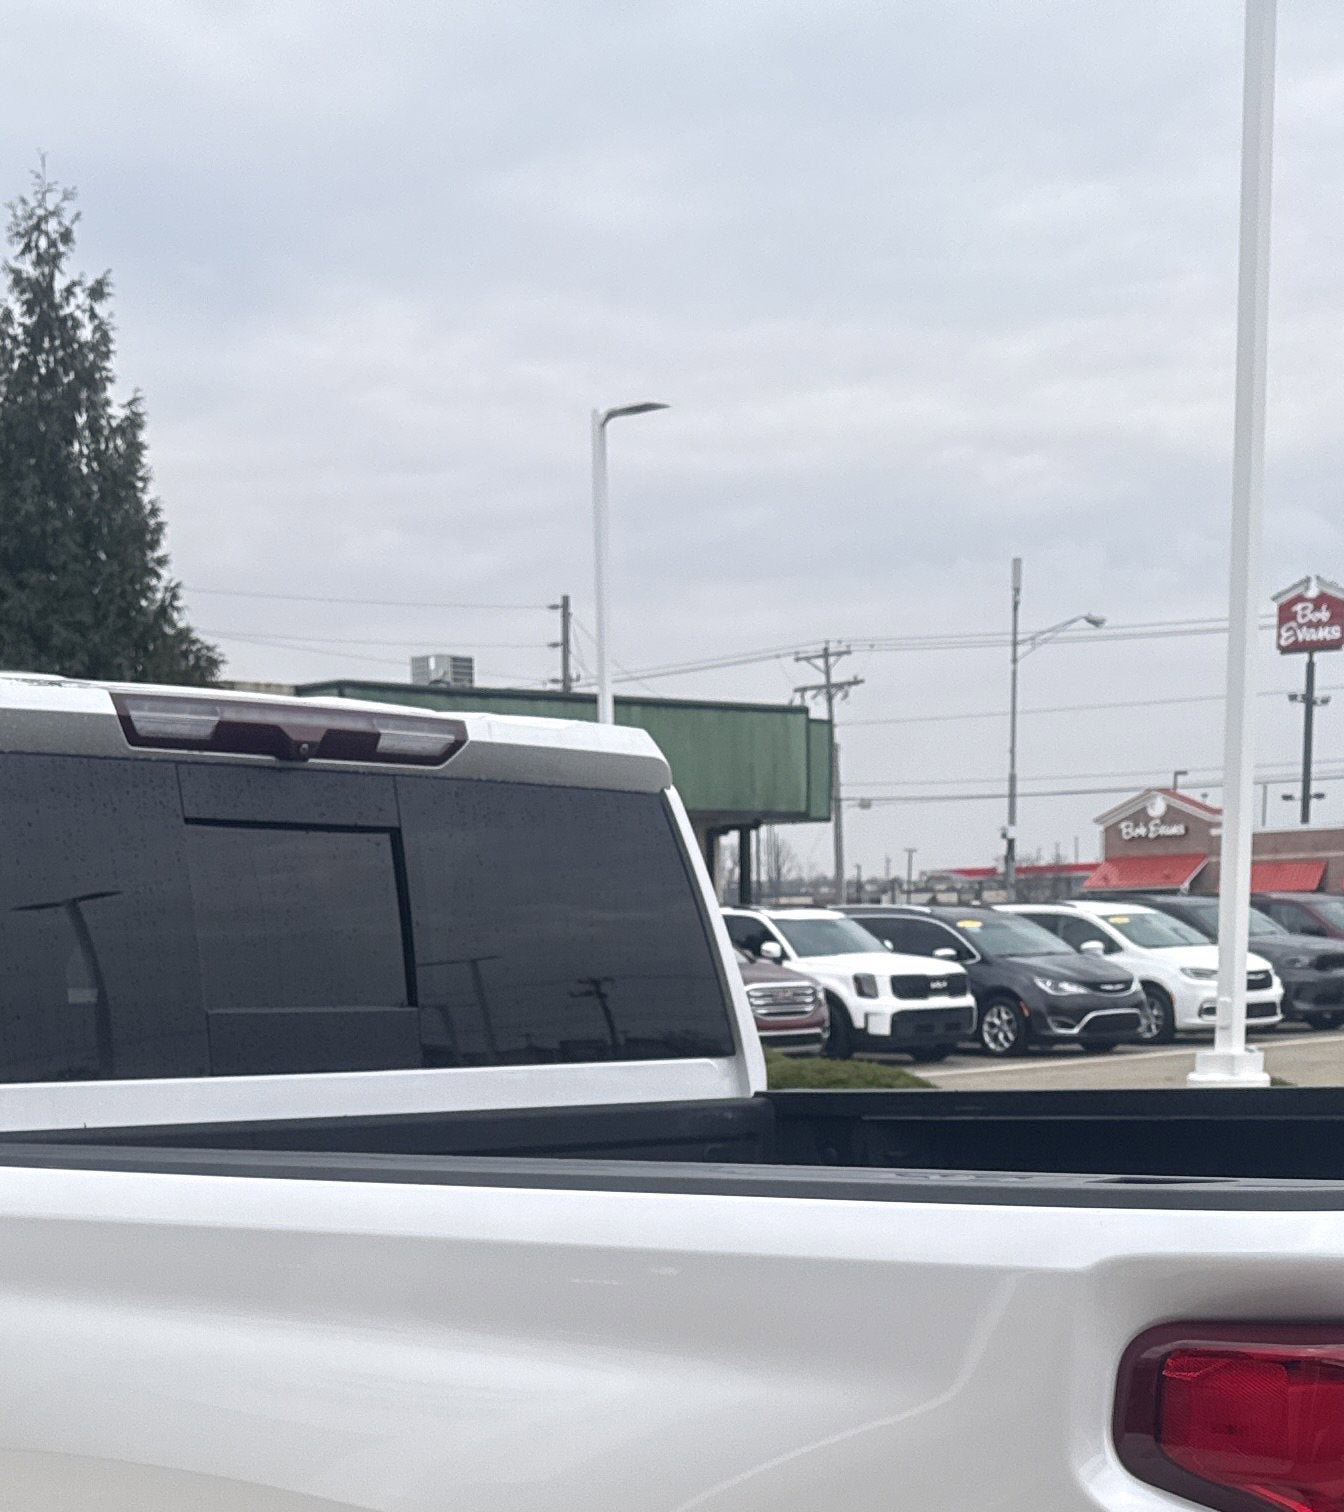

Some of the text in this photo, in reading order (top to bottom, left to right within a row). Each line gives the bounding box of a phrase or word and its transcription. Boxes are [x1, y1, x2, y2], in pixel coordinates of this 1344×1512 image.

[1291, 601, 1331, 623] Bob
[1279, 621, 1342, 646] Evans
[1119, 821, 1147, 840] Bob
